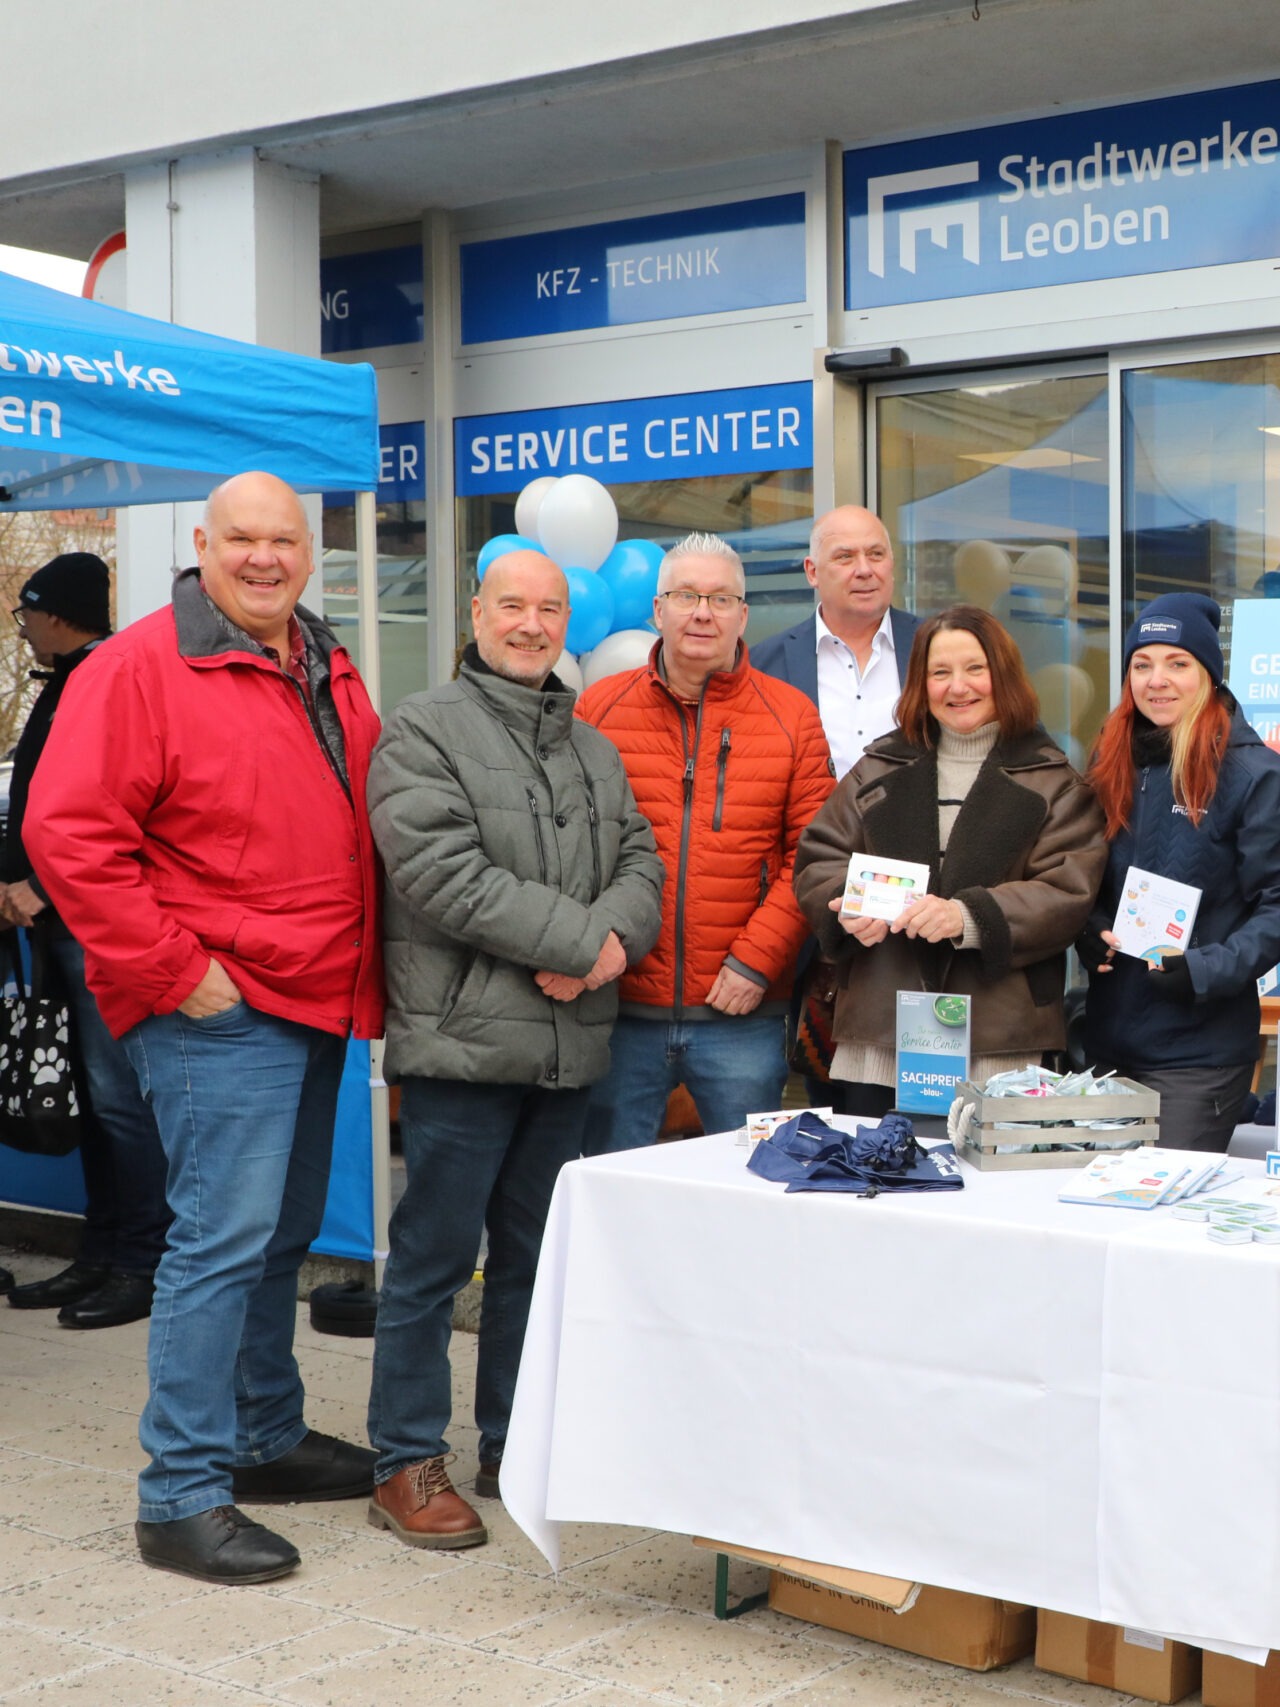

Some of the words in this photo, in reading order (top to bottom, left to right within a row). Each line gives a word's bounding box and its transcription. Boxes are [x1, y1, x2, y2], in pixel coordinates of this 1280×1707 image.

[997, 121, 1278, 204] Stadtwerke
[1000, 203, 1170, 263] Leoben
[536, 267, 583, 300] KFZ
[607, 247, 720, 288] TECHNIK
[471, 422, 628, 474] SERVICE
[644, 407, 800, 460] CENTER
[901, 1072, 962, 1086] SACHPREIS
